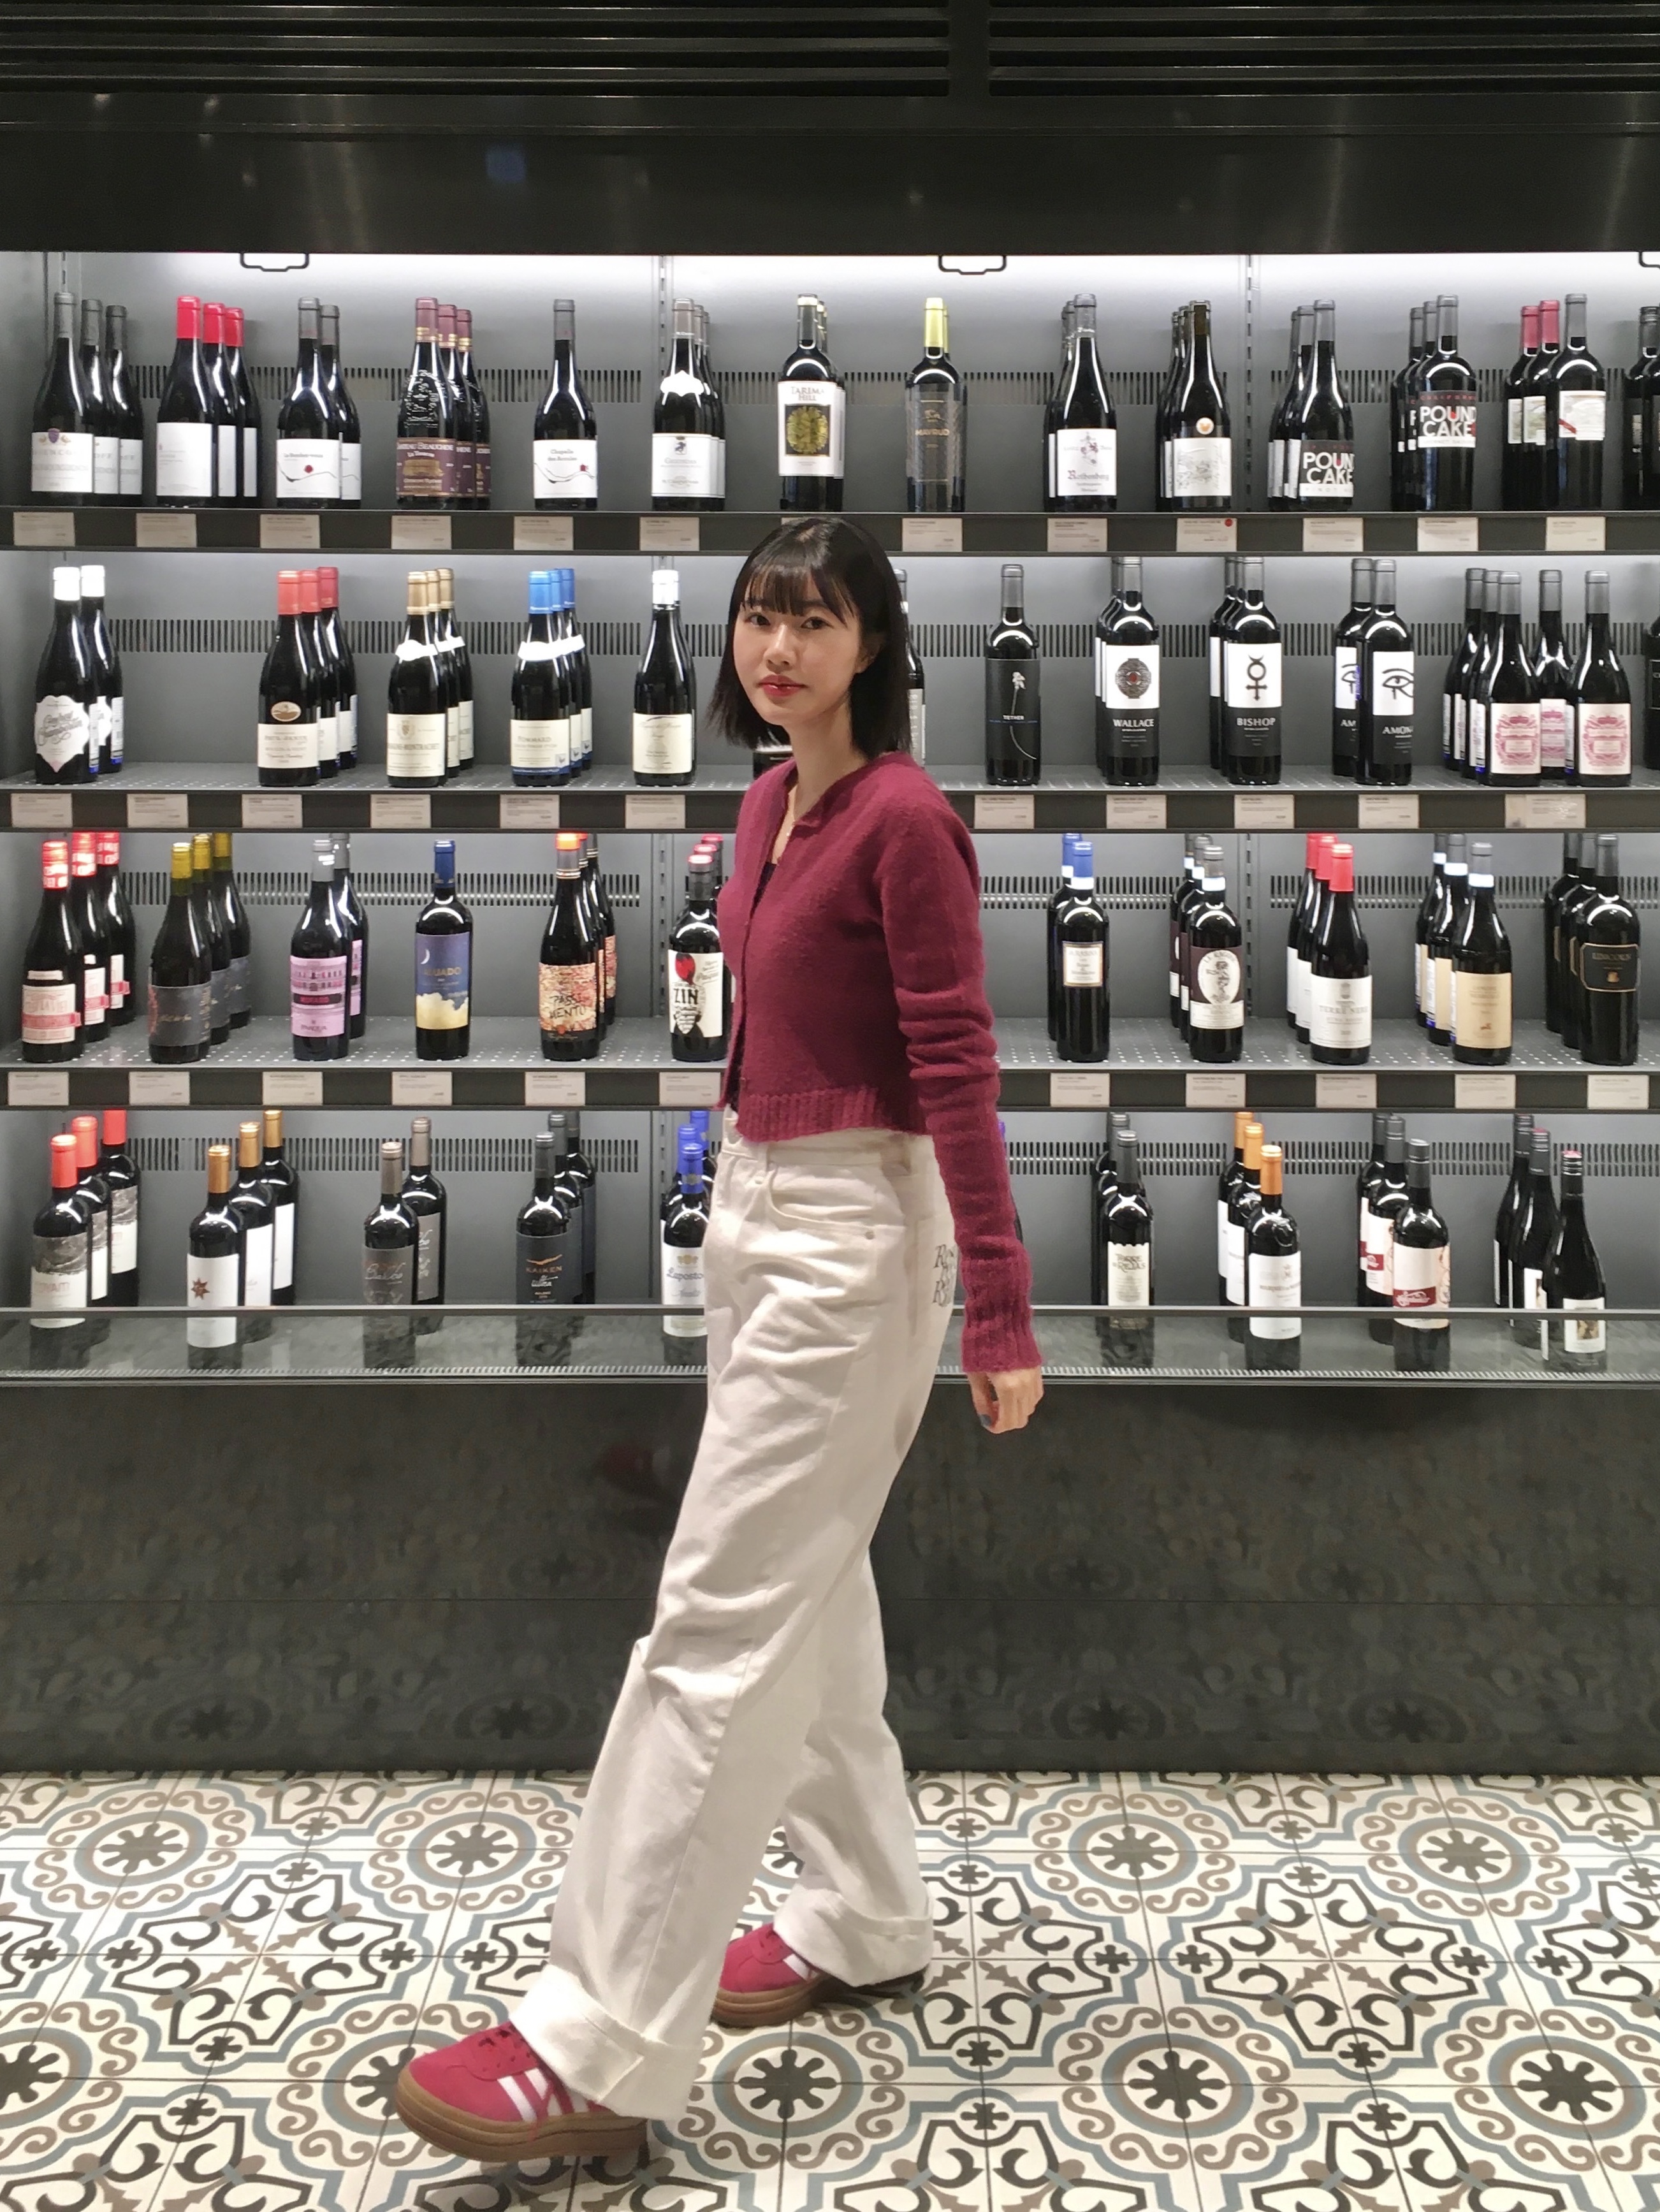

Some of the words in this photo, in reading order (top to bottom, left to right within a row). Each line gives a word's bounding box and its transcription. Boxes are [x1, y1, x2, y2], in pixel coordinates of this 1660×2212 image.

[791, 386, 824, 395] TARIMA
[1420, 405, 1477, 423] POUND
[1422, 421, 1473, 437] CAKE
[1306, 467, 1353, 484] CAKE
[1112, 718, 1154, 727] WALLACE
[1236, 717, 1276, 726] BISHOP
[673, 987, 699, 1005] ZIN
[526, 1265, 562, 1274] KAIKEN
